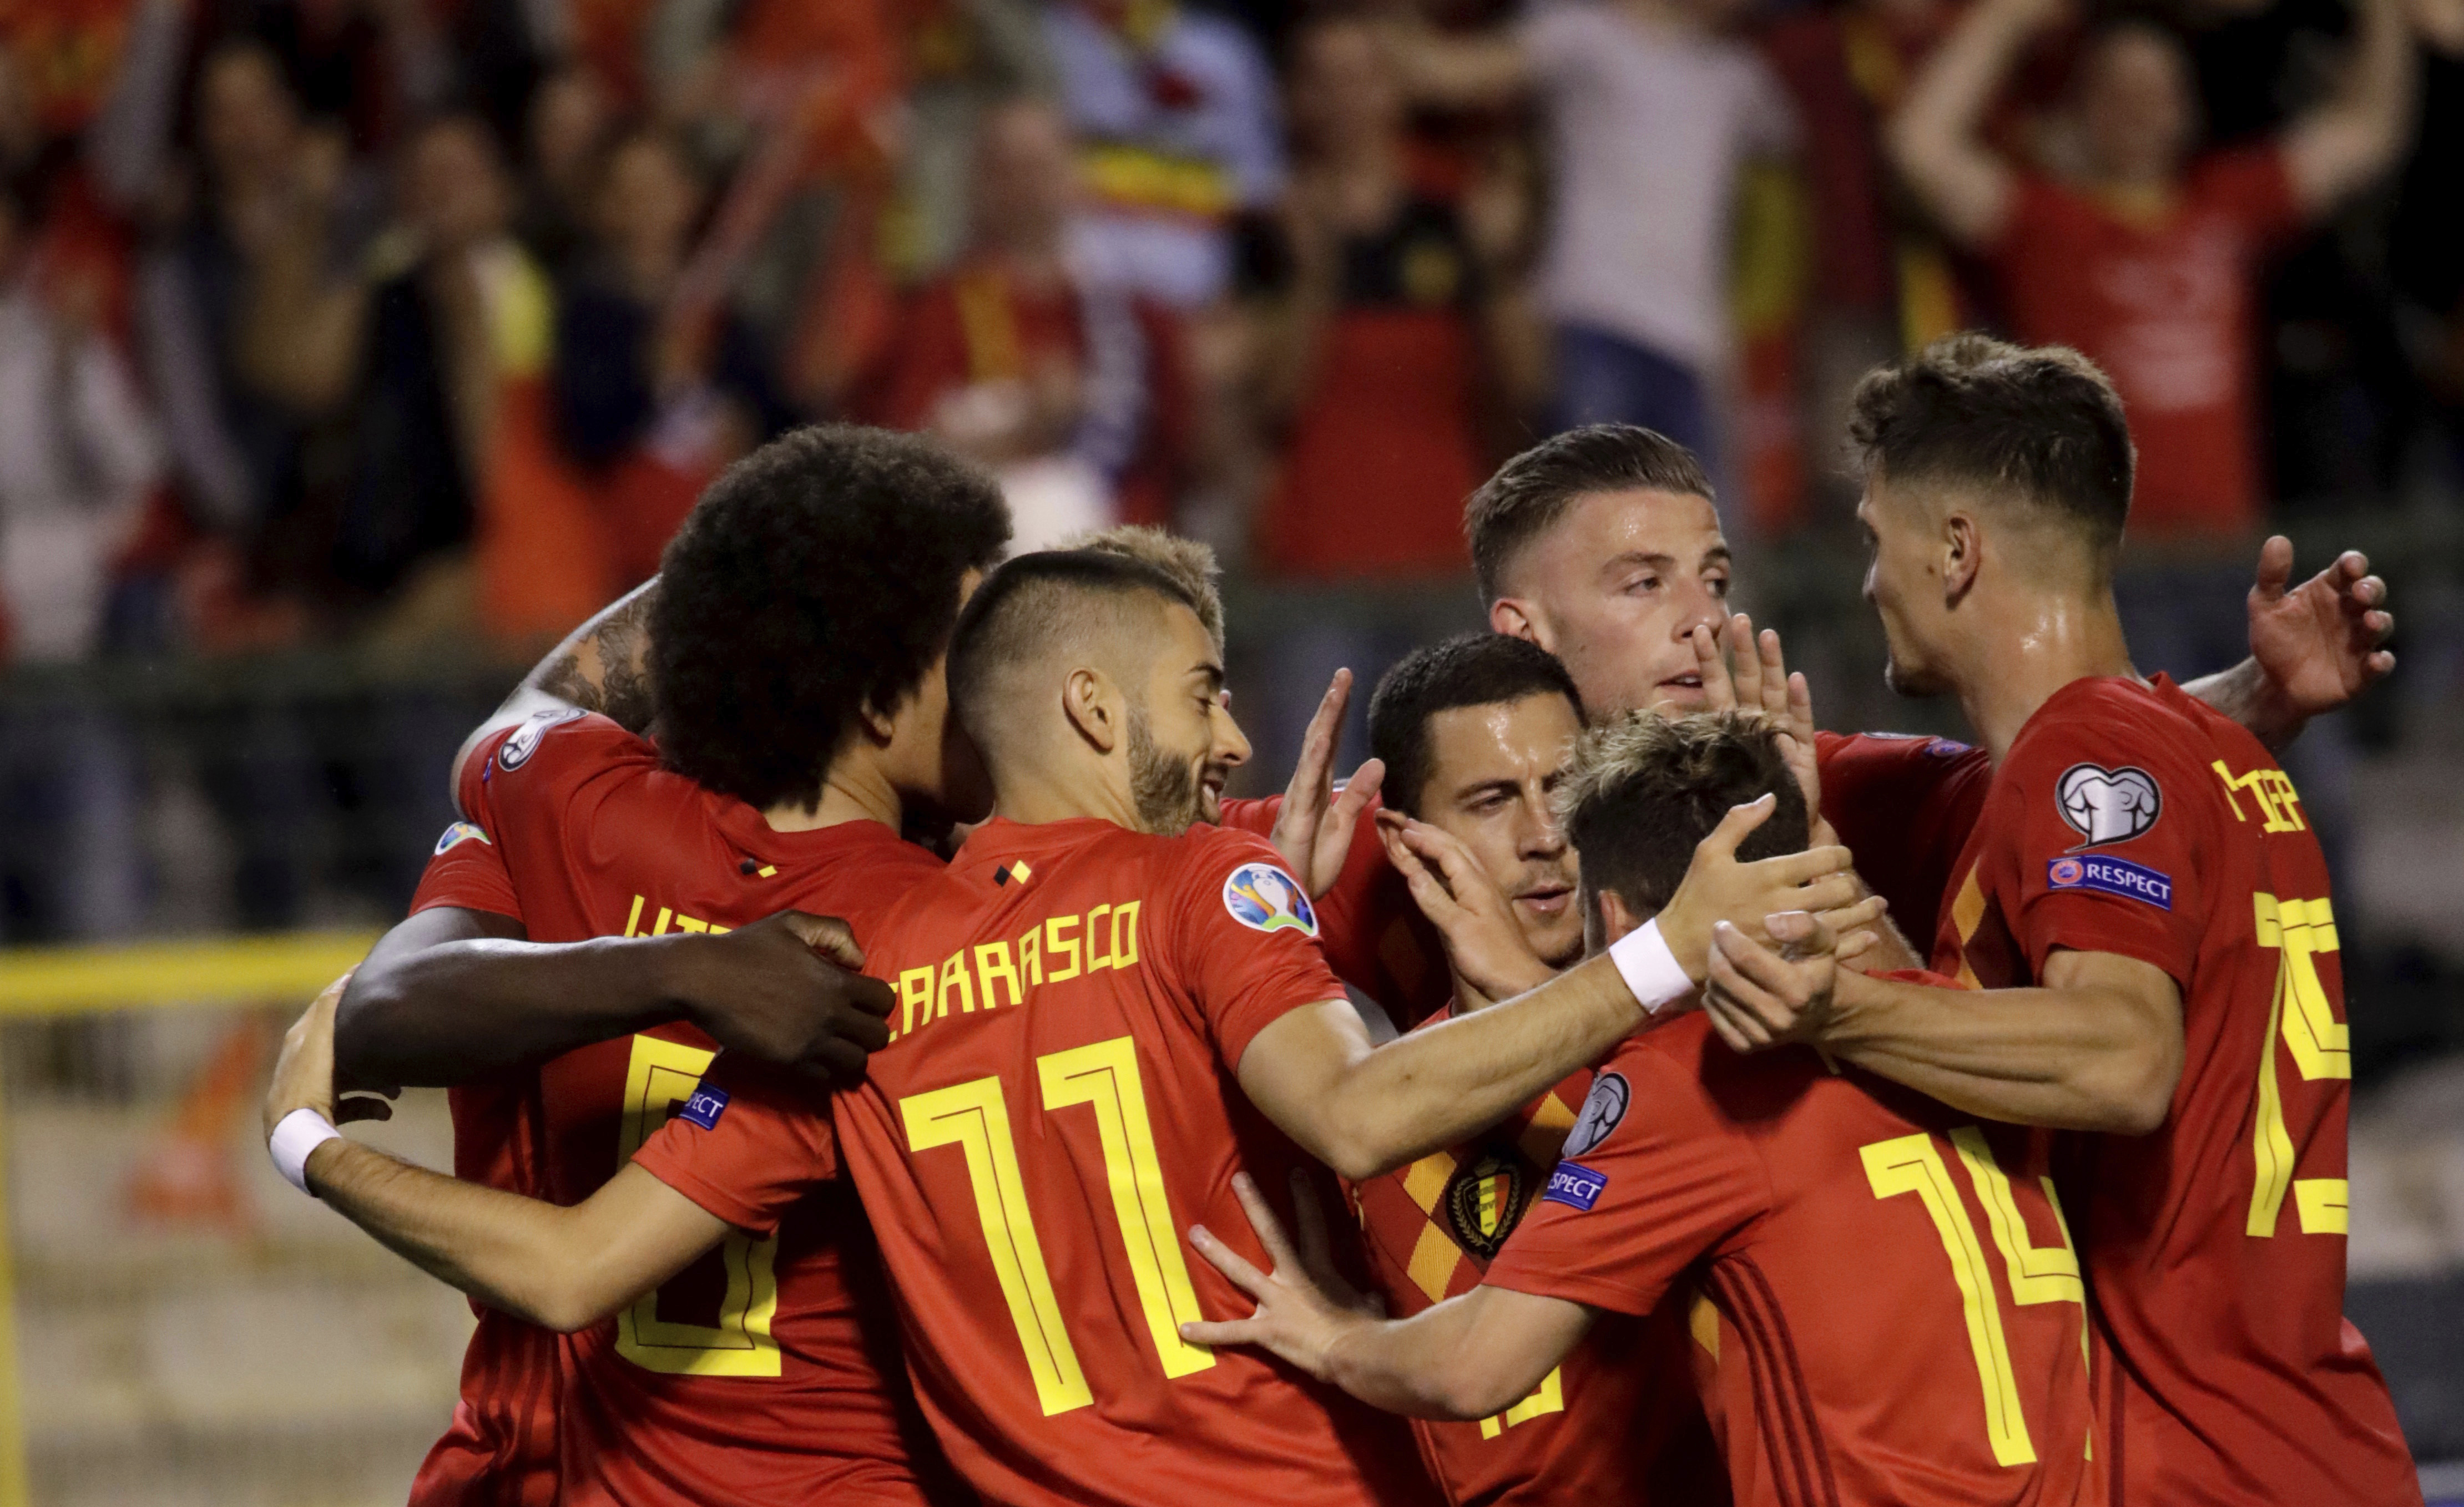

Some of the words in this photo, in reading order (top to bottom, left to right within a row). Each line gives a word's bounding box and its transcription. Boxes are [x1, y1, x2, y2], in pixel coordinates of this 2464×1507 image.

[2087, 863, 2171, 900] RESPECT
[888, 900, 1141, 1043] ARRASCO
[685, 1092, 724, 1118] PECT
[898, 1035, 1216, 1417] 11
[1547, 1172, 1602, 1200] SPECT
[1859, 1125, 2093, 1468] 14
